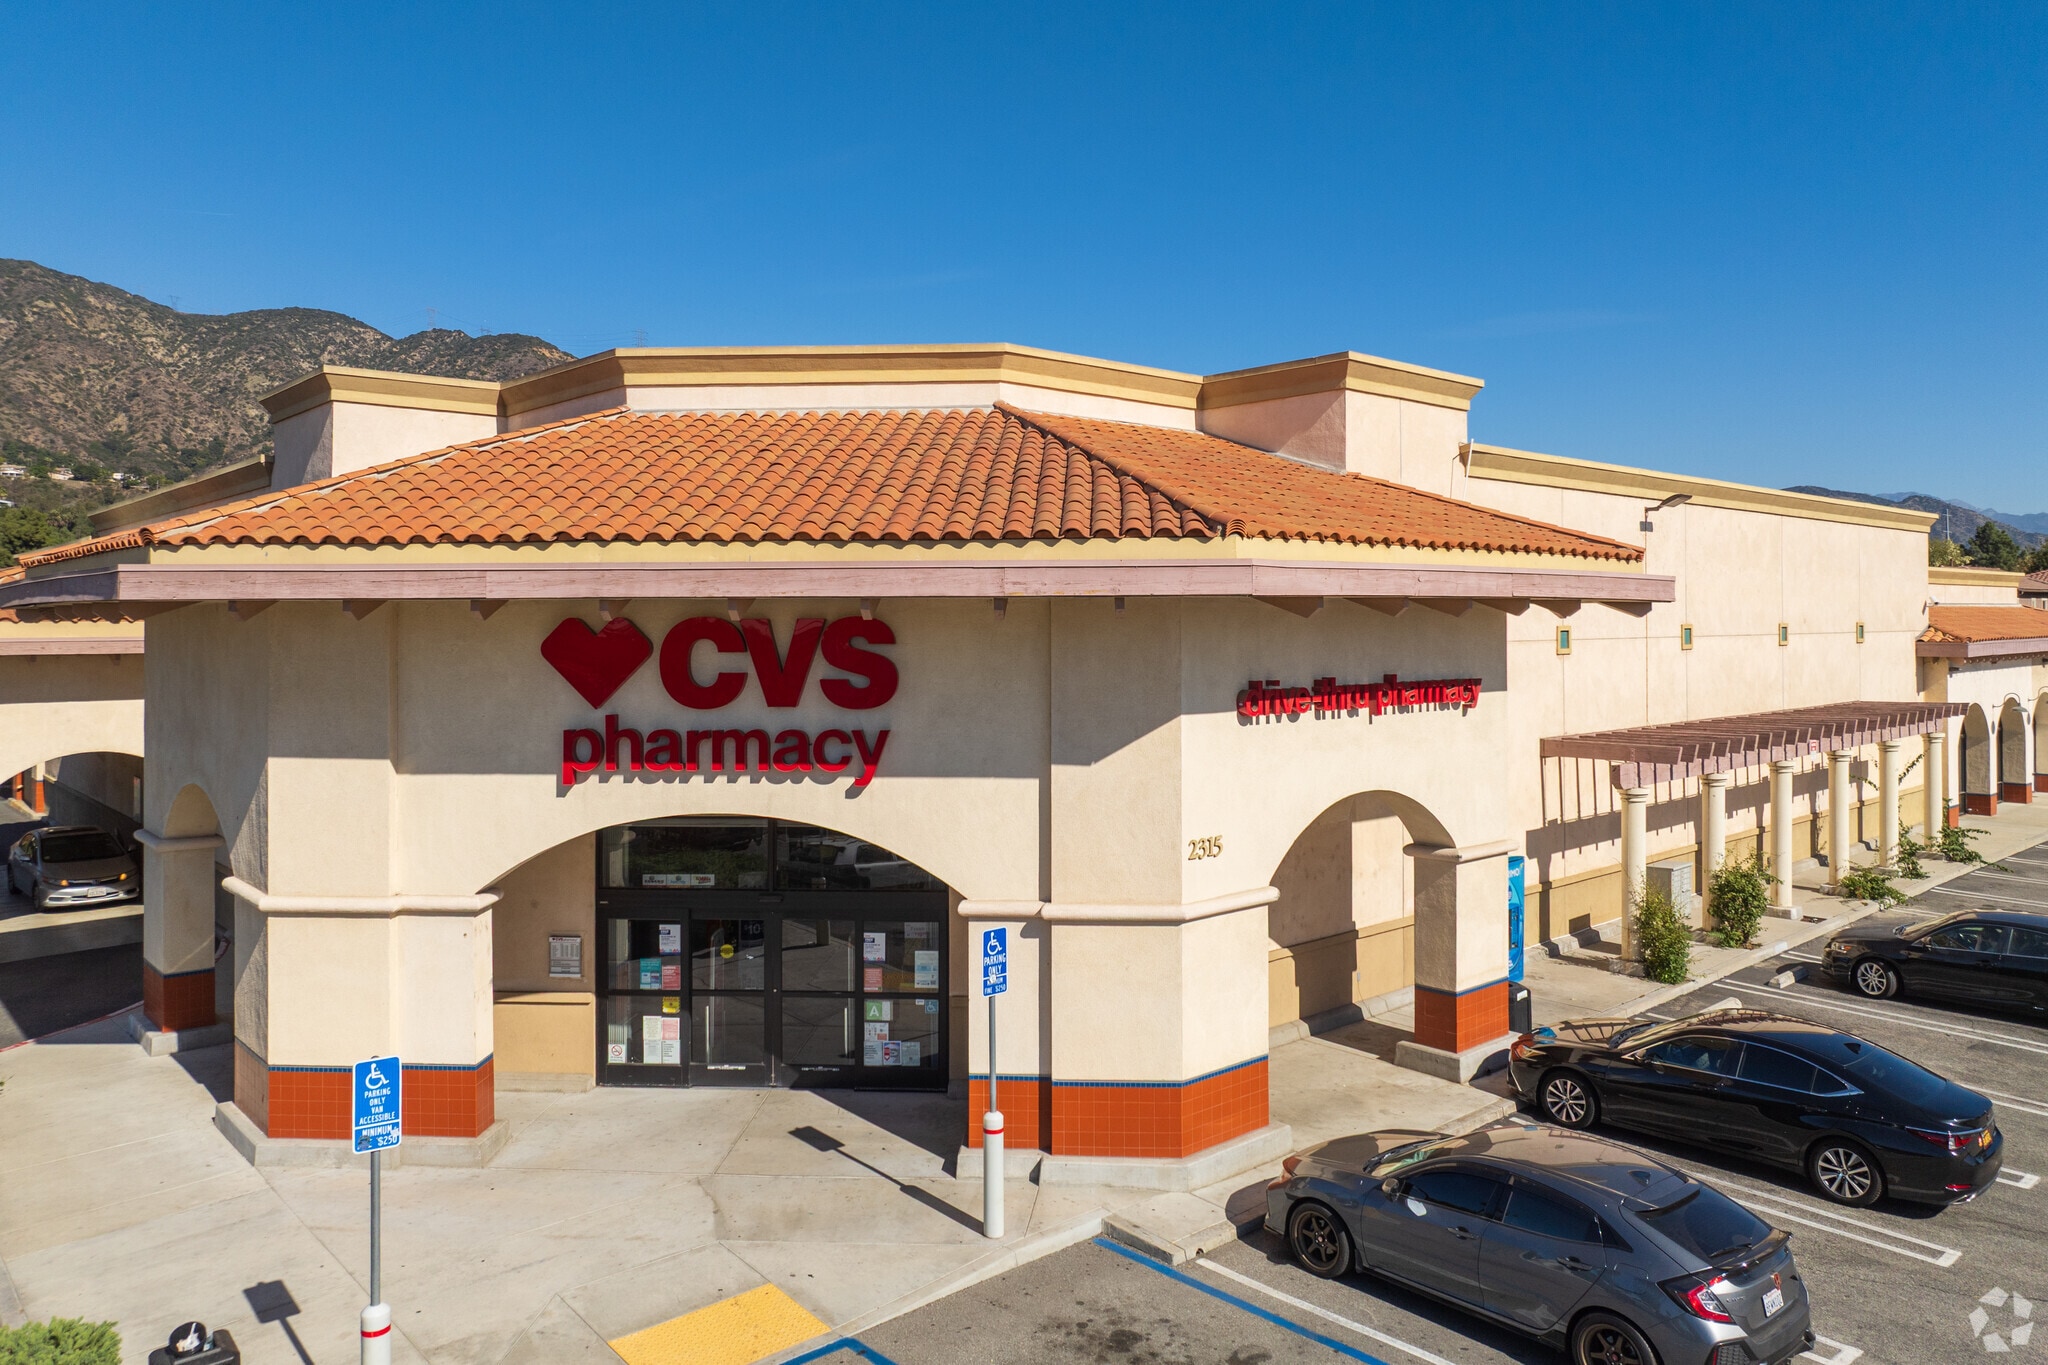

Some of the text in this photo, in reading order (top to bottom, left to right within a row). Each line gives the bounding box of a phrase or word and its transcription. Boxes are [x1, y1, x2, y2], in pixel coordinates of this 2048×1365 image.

[659, 616, 899, 710] CVS
[1237, 674, 1482, 717] drive-thru pharmacy
[562, 714, 891, 787] pharmacy
[1188, 835, 1223, 860] 2315
[984, 953, 1006, 966] PARKING
[988, 965, 1002, 975] ONLY
[869, 1005, 879, 1017] A
[364, 1087, 390, 1098] PARKING
[369, 1097, 385, 1106] ONLY
[371, 1105, 383, 1114] VAN
[359, 1112, 395, 1125] ACCESSIBLE
[362, 1124, 393, 1137] MINIMUM
[377, 1135, 397, 1147] $250
